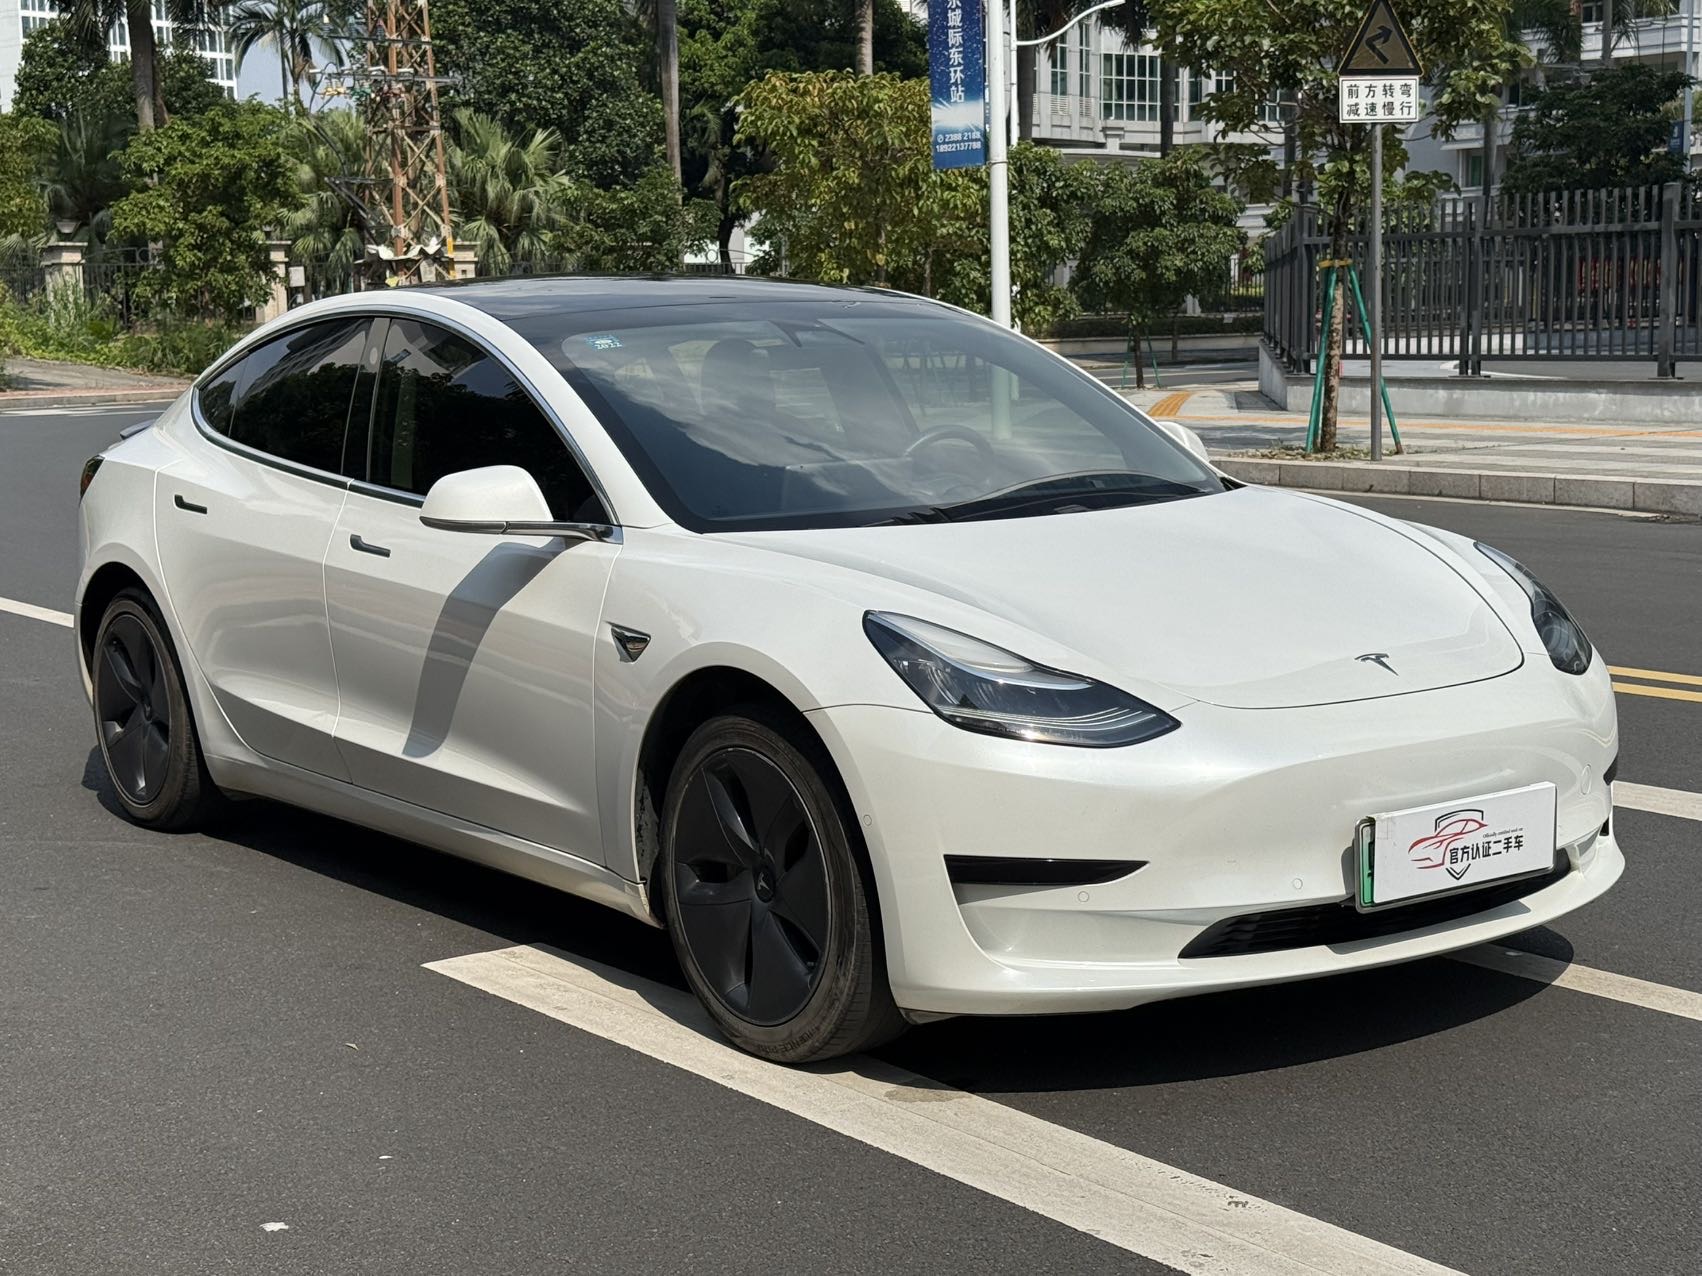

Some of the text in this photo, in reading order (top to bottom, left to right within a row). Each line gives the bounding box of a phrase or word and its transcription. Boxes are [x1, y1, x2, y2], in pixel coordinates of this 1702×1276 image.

[1346, 83, 1412, 99] 前方转弯
[1346, 101, 1413, 117] 减速慢行
[1450, 835, 1523, 864] 官方认证二手车
